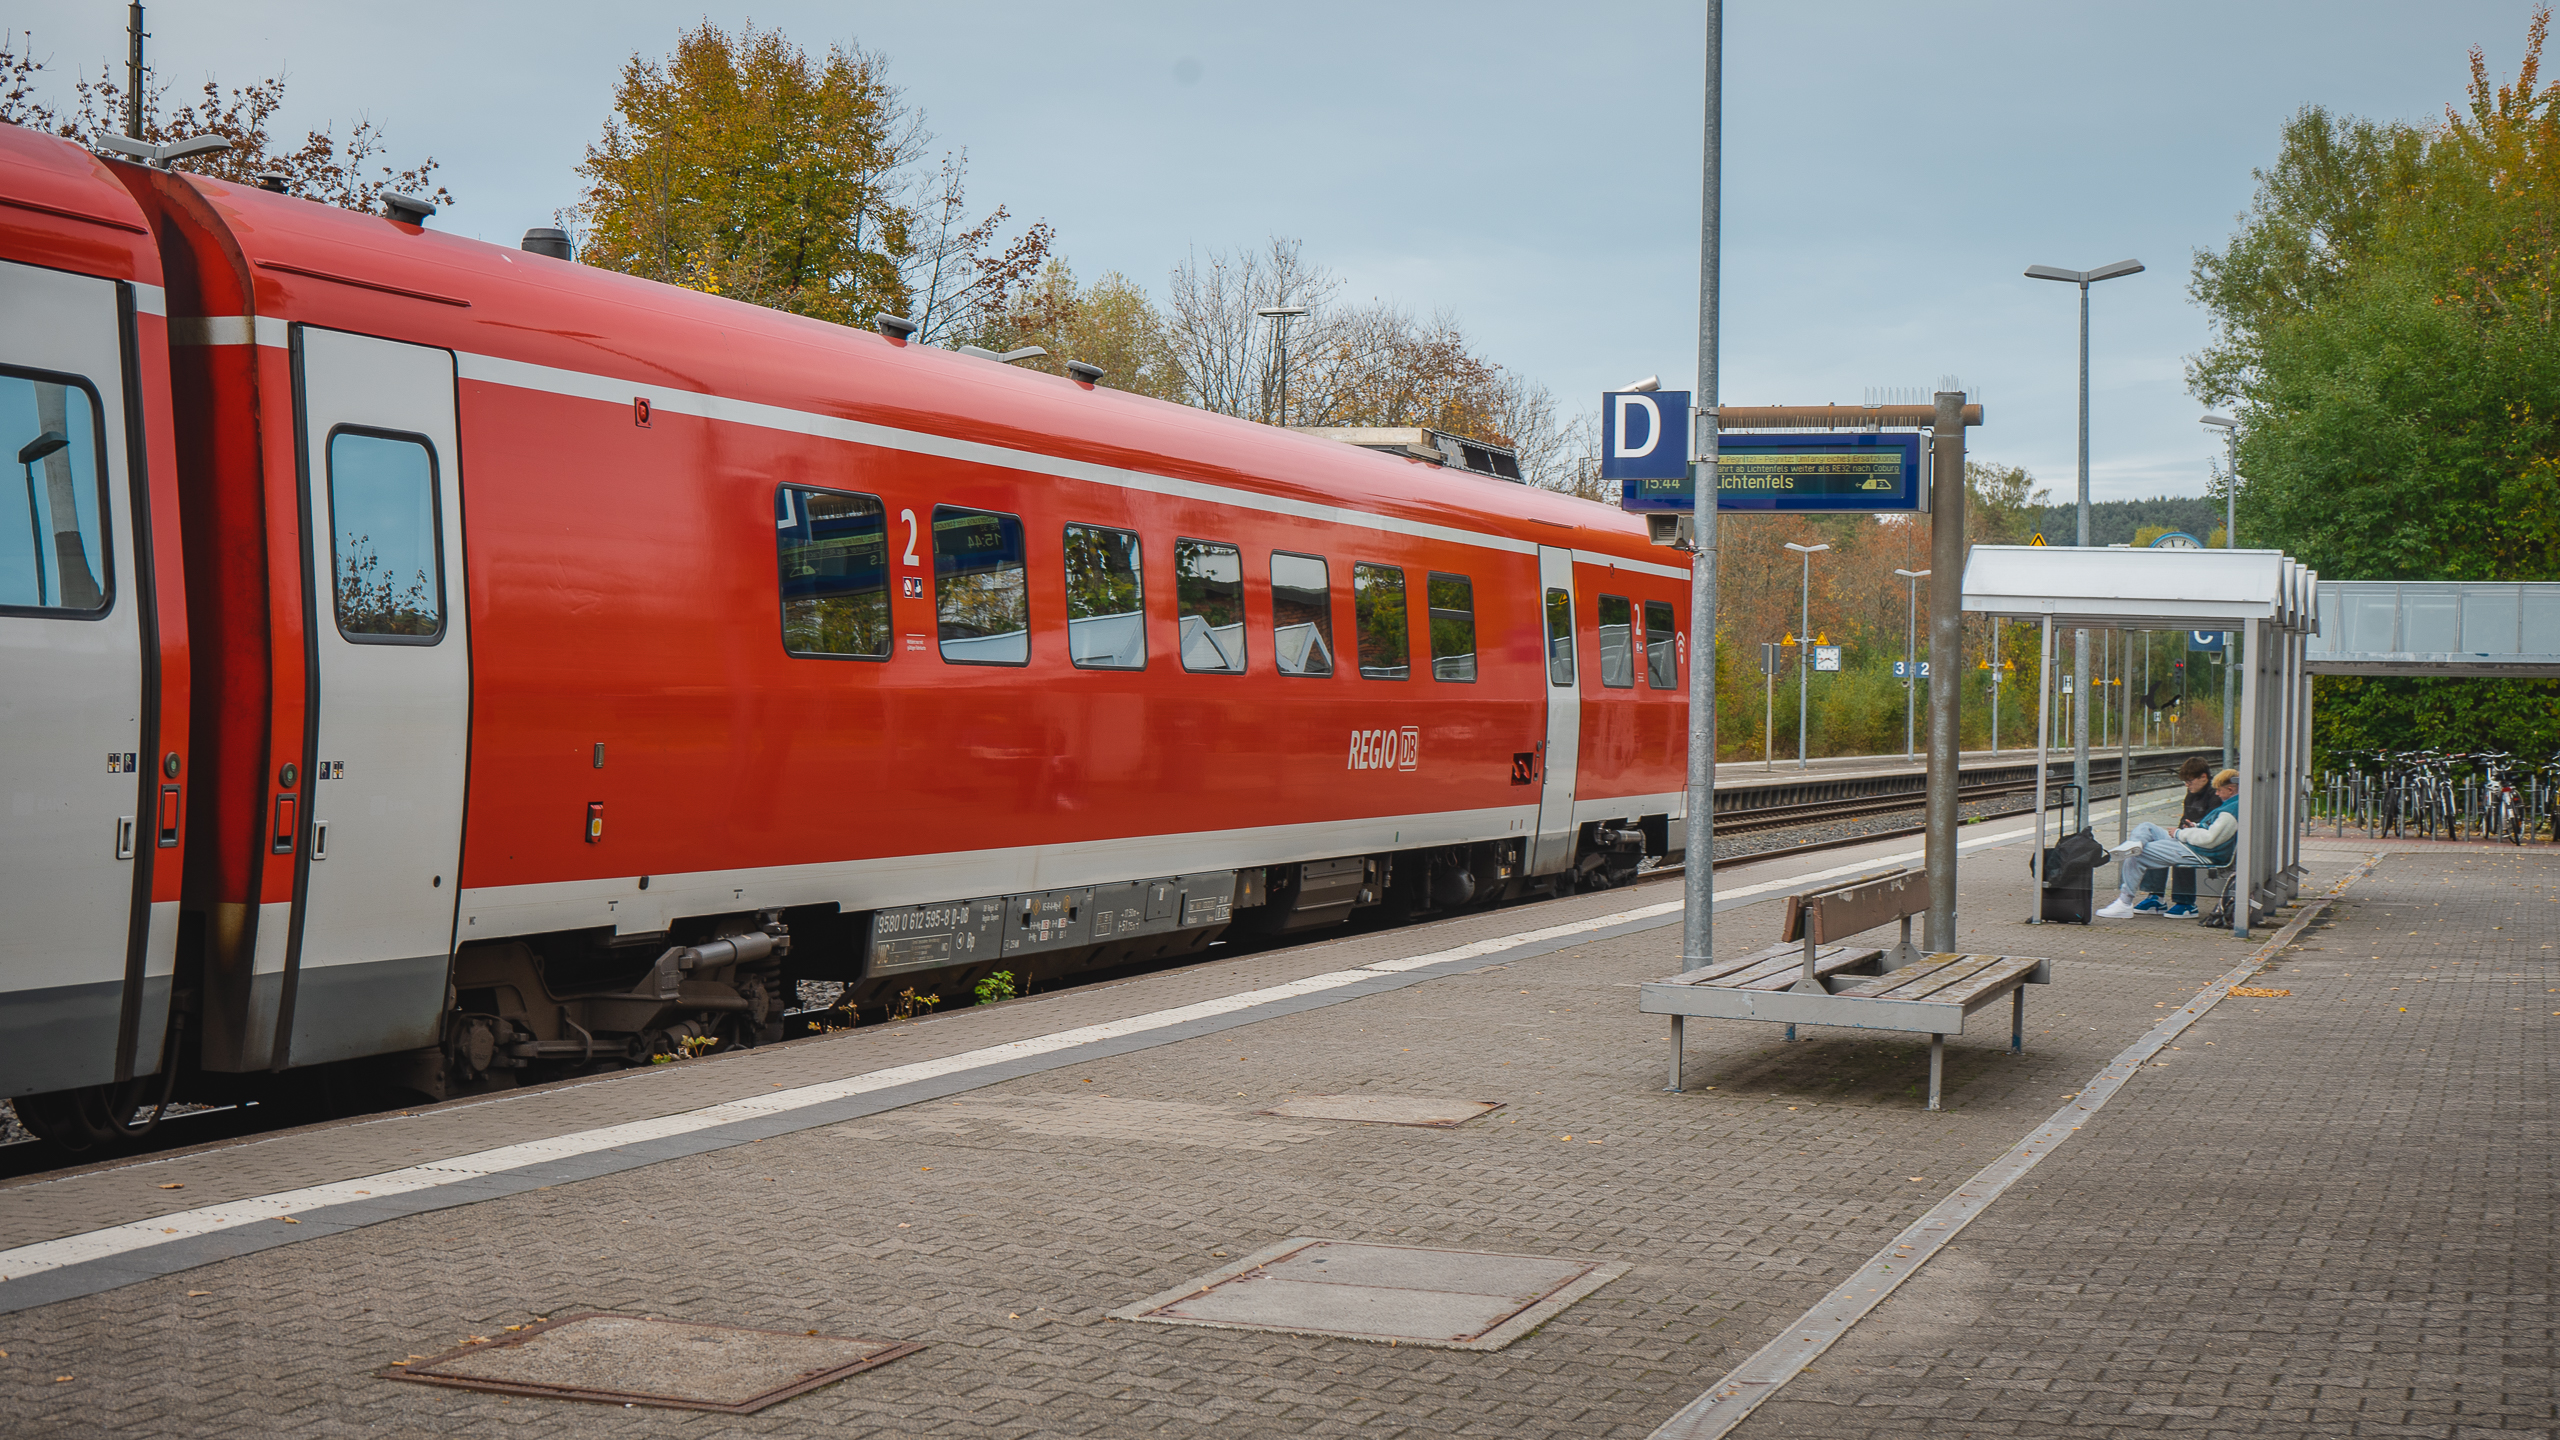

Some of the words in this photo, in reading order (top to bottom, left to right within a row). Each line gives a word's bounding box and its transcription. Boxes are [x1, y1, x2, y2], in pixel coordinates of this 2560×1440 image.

[1613, 394, 1661, 458] D
[1717, 465, 1734, 473] ahrt
[1736, 465, 1745, 473] ab
[1747, 464, 1789, 473] Lichtenfels
[1790, 464, 1816, 473] weiter
[1818, 464, 1830, 473] als
[1832, 464, 1851, 473] RE32
[1853, 464, 1871, 472] nach
[1873, 464, 1899, 474] Coburg
[1717, 474, 1794, 489] ichtenfels
[900, 507, 920, 567] 2
[1633, 603, 1642, 636] 2
[1895, 662, 1905, 675] 3
[1920, 662, 1930, 676] 2
[1347, 729, 1398, 770] REGIO
[1400, 731, 1418, 767] DB
[878, 914, 901, 934] 9580
[901, 913, 908, 931] 0
[909, 911, 925, 930] 612
[925, 908, 951, 928] 595-8
